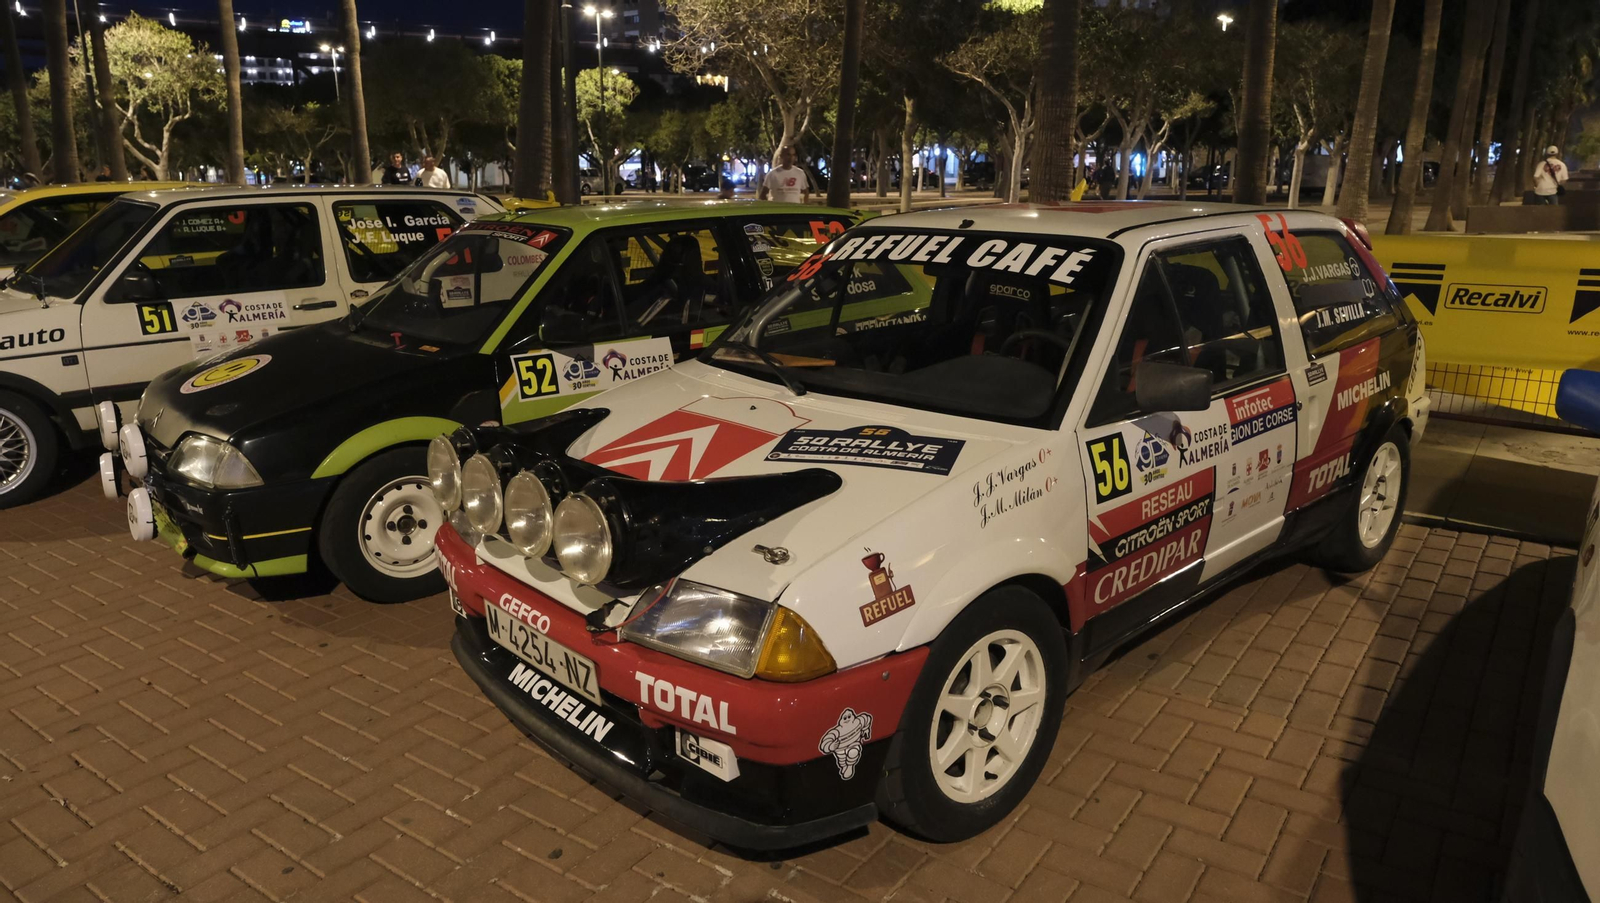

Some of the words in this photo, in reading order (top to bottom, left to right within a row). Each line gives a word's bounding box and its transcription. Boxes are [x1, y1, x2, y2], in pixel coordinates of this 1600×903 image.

[347, 218, 383, 230] Jose
[404, 214, 450, 226] García
[381, 231, 425, 245] Luque
[1255, 213, 1308, 272] 56
[787, 253, 835, 282] 56
[828, 234, 966, 264] REFUEL
[966, 239, 1097, 285] CAFÉ
[989, 283, 1031, 298] sparco
[1450, 288, 1542, 309] Recalvi
[141, 305, 172, 333] 51
[239, 309, 286, 323] ALMERÍA
[244, 303, 271, 312] COSTA
[1334, 303, 1365, 325] SEVILLA
[0, 328, 65, 350] auto
[630, 355, 657, 366] COSTA
[658, 353, 669, 362] DE
[518, 357, 557, 396] 52
[572, 381, 582, 391] 30
[1337, 370, 1391, 411] MICHELIN
[1233, 394, 1274, 421] infotec
[1252, 418, 1264, 435] DE
[1265, 406, 1294, 429] CORSE
[793, 436, 829, 446] 50
[830, 437, 943, 455] RALLYE
[859, 428, 893, 436] 56
[1194, 428, 1218, 444] COSTA
[1218, 423, 1227, 435] DE
[788, 445, 836, 453] COSTA
[1189, 437, 1230, 466] ALMERÍA
[1090, 438, 1129, 497] 56
[1144, 471, 1153, 485] 30
[1307, 452, 1351, 494] TOTAL
[1141, 481, 1193, 520] RESEAU
[1115, 518, 1174, 558] CITROËN
[1176, 499, 1210, 529] SPORT
[1094, 528, 1202, 605] CREDIPAR
[499, 592, 551, 635] GEFCO
[863, 590, 912, 622] REFUEL
[507, 662, 615, 743] MICHELIN
[634, 670, 737, 735] TOTAL
